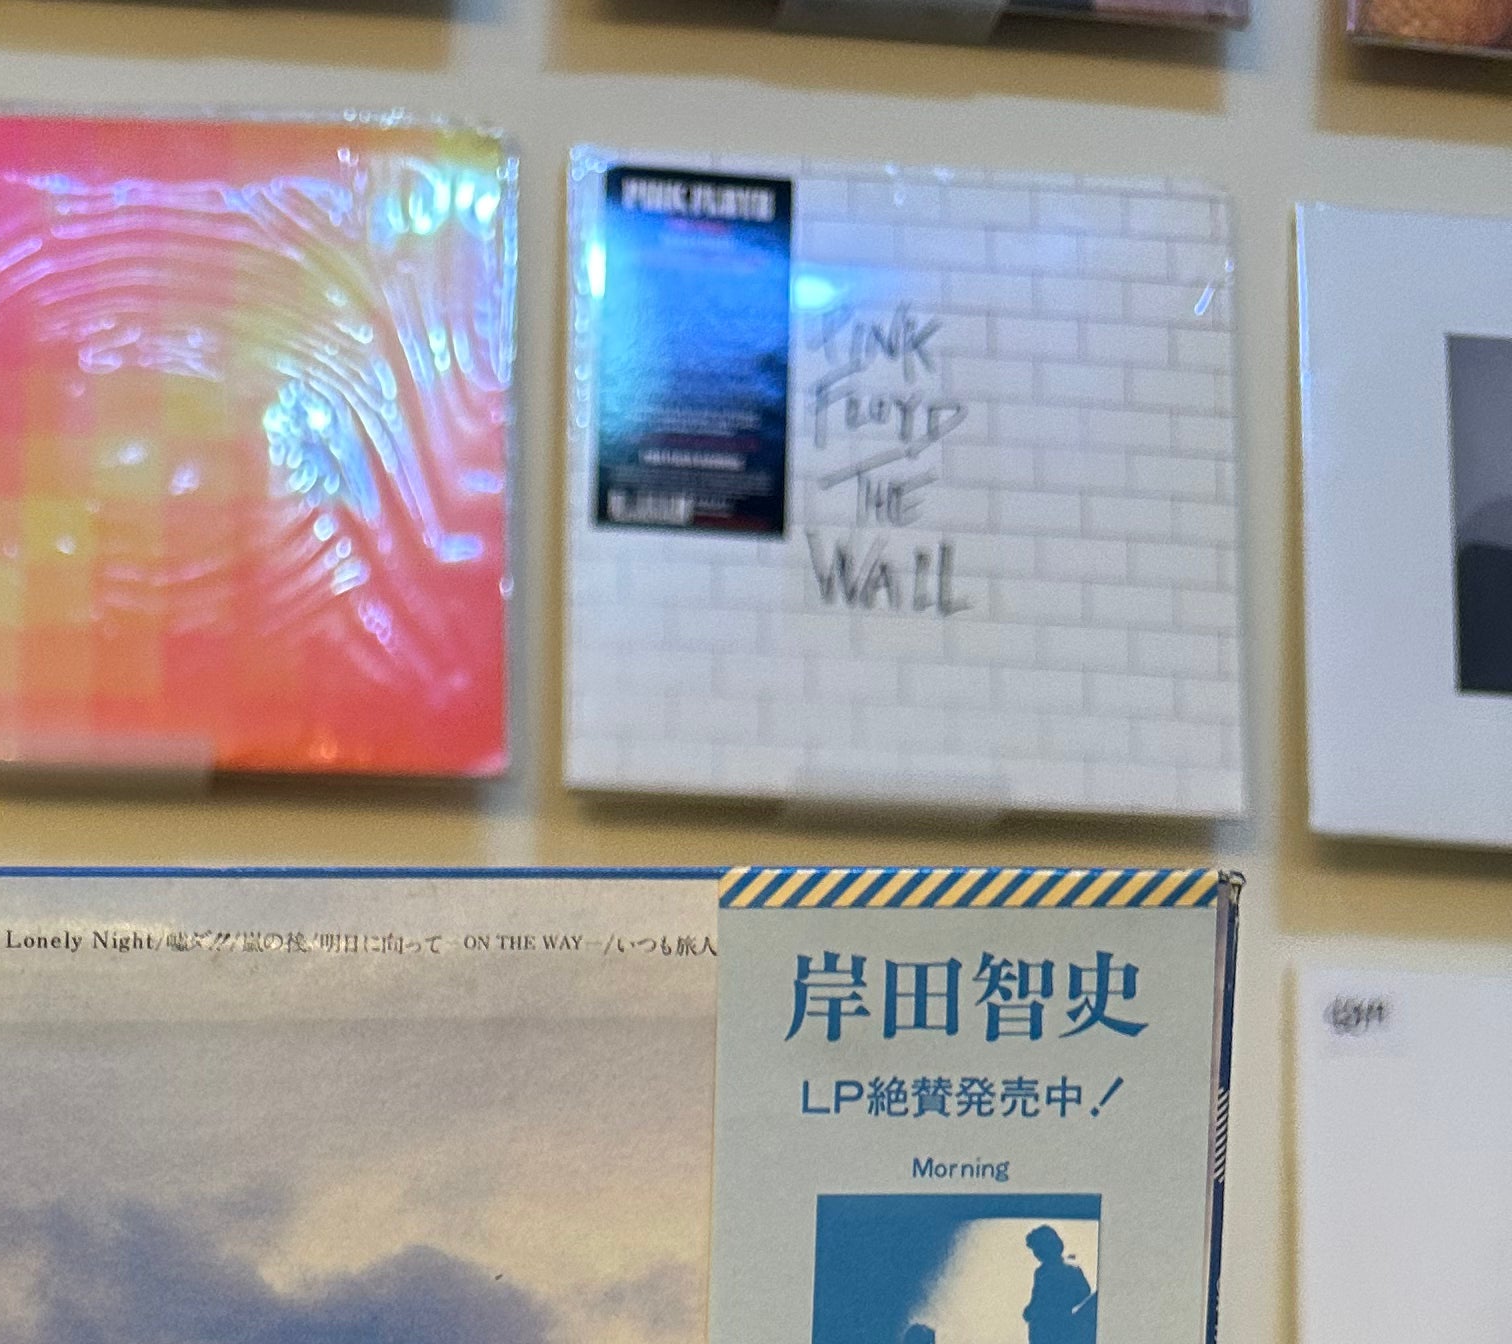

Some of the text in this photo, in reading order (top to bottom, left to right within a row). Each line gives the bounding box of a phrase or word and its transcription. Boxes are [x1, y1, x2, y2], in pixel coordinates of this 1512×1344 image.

[5, 929, 82, 953] Lonely
[496, 934, 535, 951] THE
[785, 950, 1149, 1042] 岸田智史
[912, 1156, 1010, 1181] Morning
